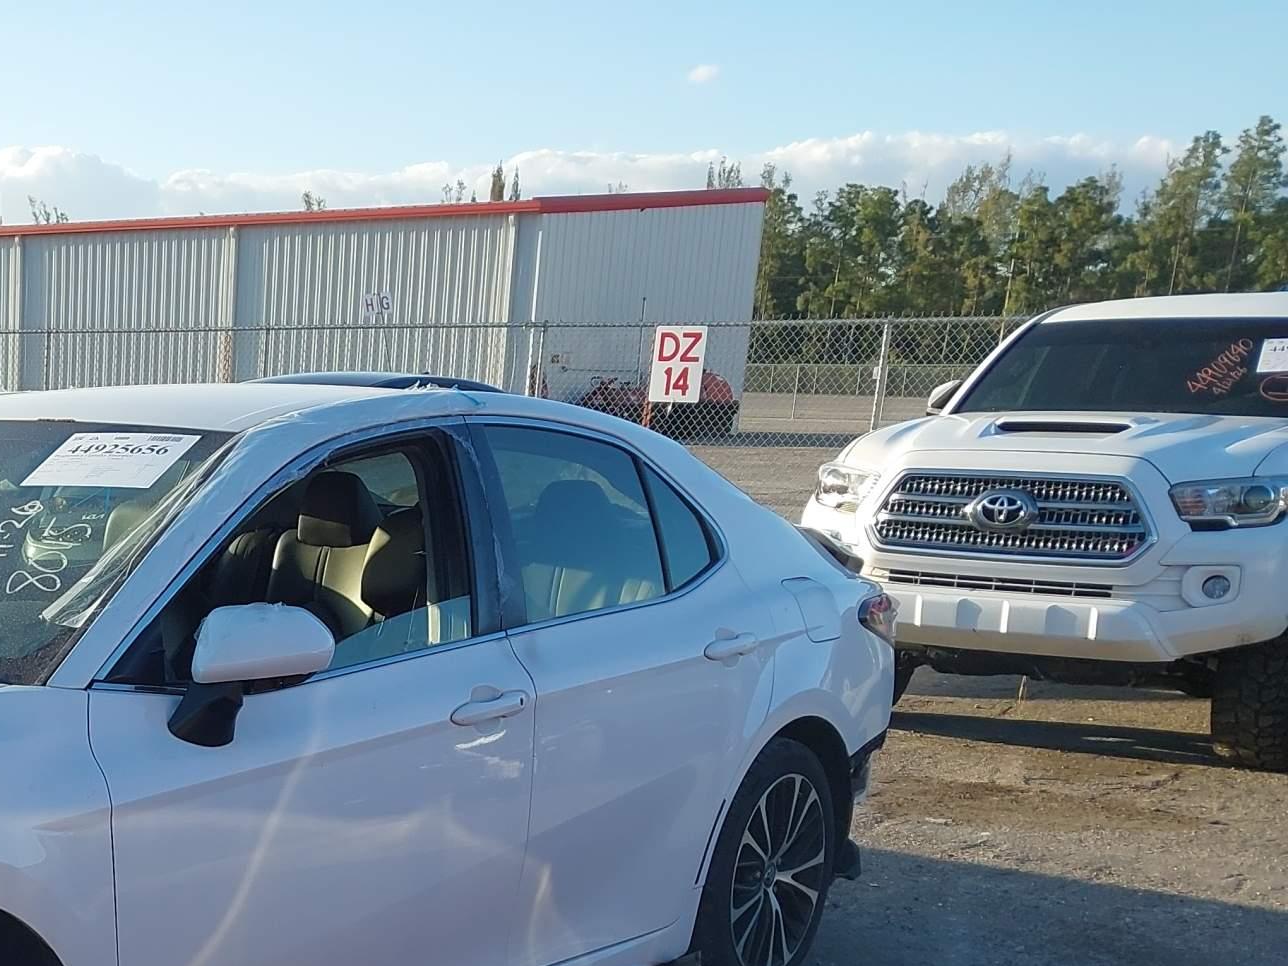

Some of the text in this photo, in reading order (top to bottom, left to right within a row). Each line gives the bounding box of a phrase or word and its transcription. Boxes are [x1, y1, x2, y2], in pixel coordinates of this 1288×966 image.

[381, 295, 390, 310] G
[657, 331, 703, 363] DZ
[664, 366, 689, 396] 14
[68, 443, 171, 456] 44925656
